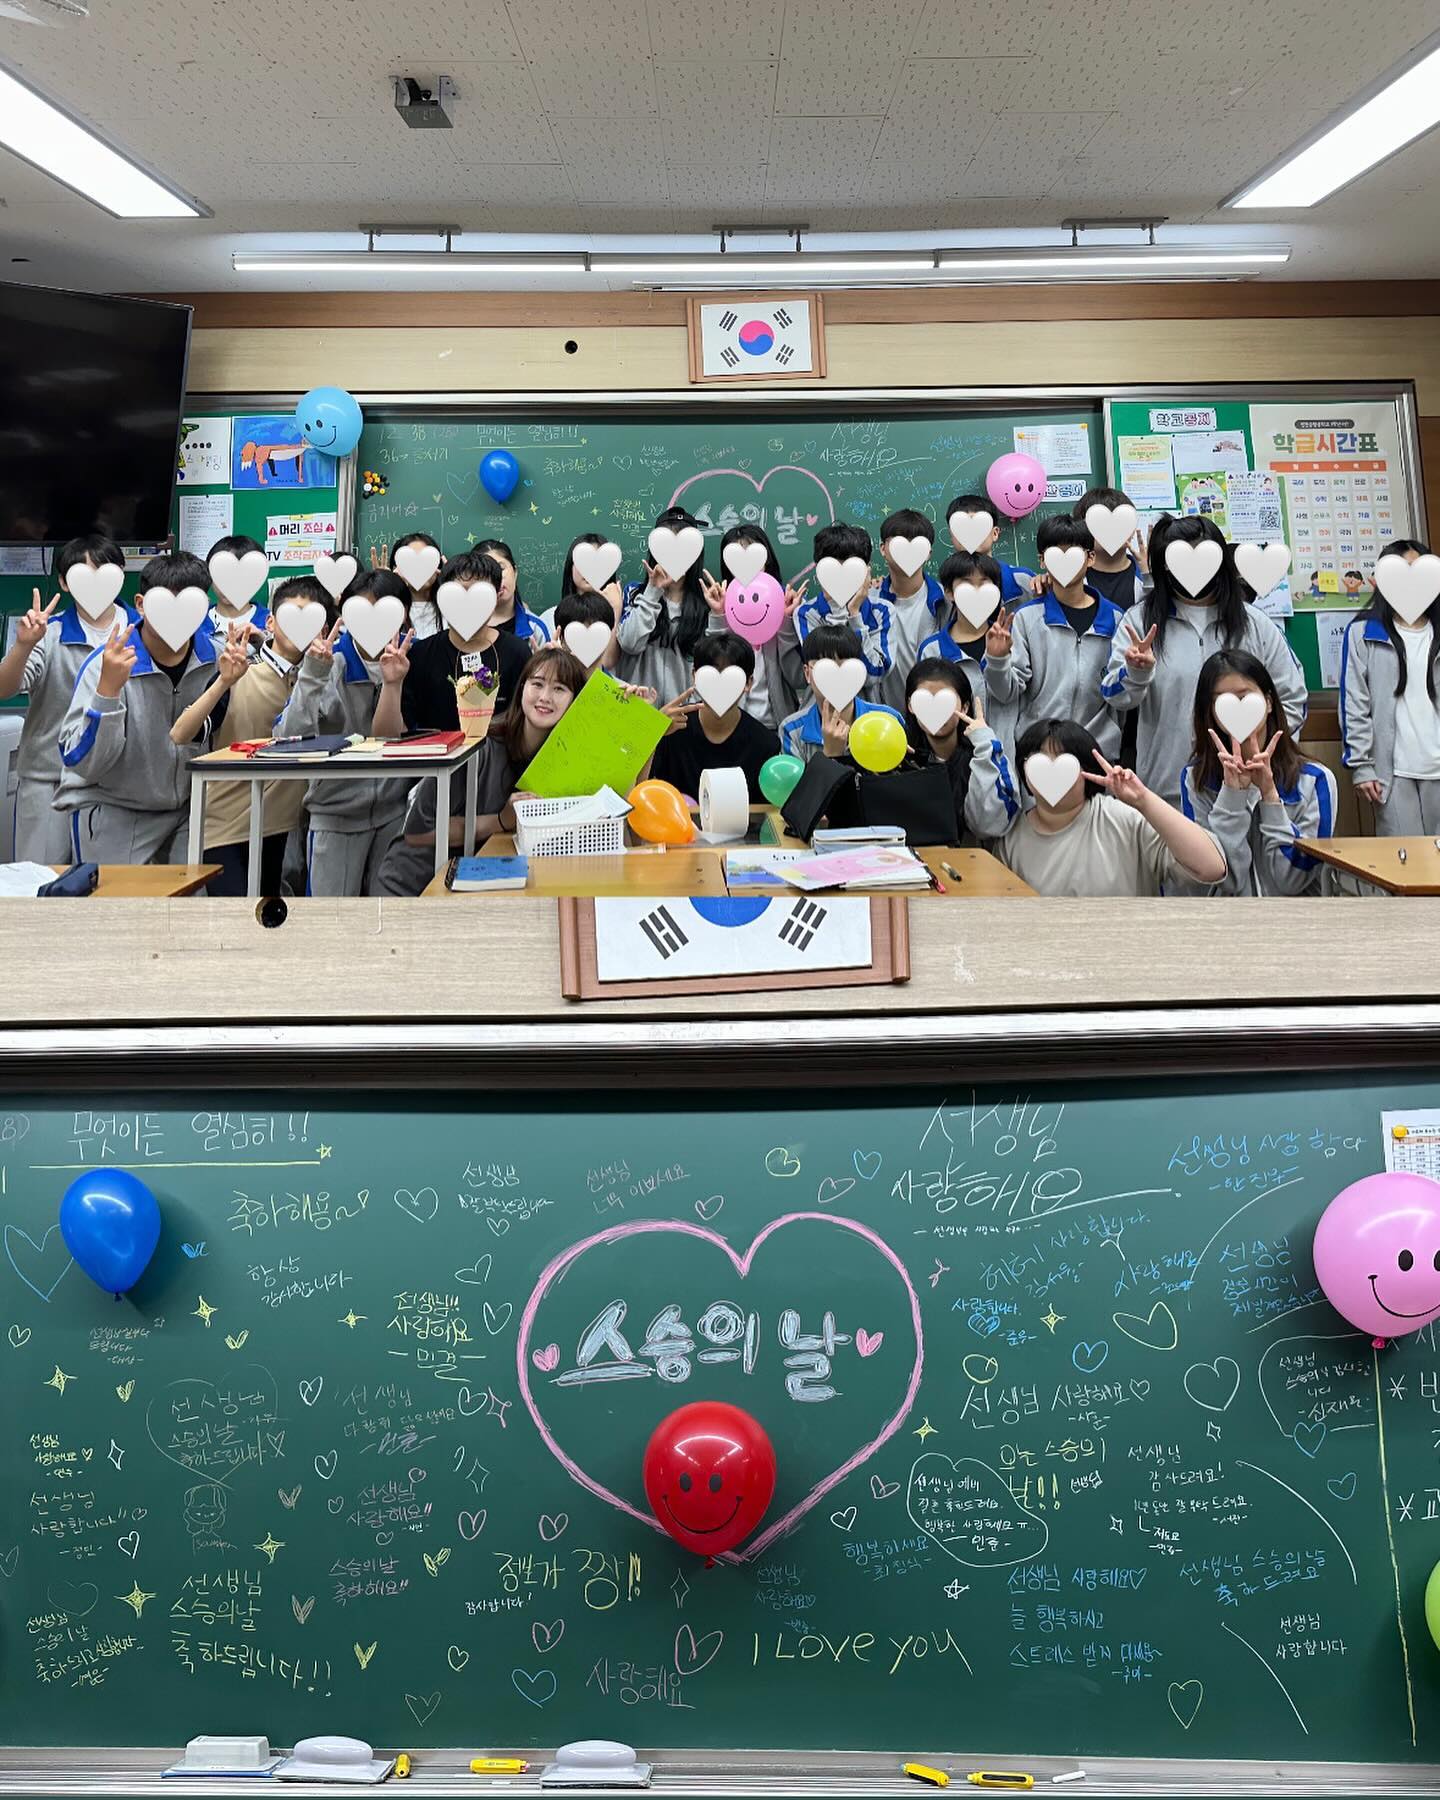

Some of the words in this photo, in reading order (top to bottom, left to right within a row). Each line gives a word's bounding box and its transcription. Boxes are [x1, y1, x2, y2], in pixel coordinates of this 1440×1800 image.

[1272, 433, 1379, 454] 학급시간표
[279, 523, 300, 536] 머리
[303, 522, 323, 534] 조심
[267, 551, 281, 561] TV
[67, 1110, 164, 1161] 무엇이든
[463, 1161, 520, 1188] 선생님
[549, 1299, 761, 1387] 스승의
[777, 1308, 853, 1402] 날
[171, 1391, 265, 1423] 선생님
[960, 1383, 1040, 1430] 선생님
[1051, 1381, 1130, 1411] 사랑해요
[1044, 1436, 1105, 1463] 스승의
[1127, 1443, 1182, 1465] 선생님
[357, 1479, 418, 1506] 선생님
[913, 1472, 954, 1495] 선생님
[30, 1491, 95, 1516] 선생님
[1152, 1525, 1181, 1542] 저도요
[181, 1569, 262, 1597] 선생님
[1007, 1565, 1061, 1594] 선생님
[1179, 1556, 1243, 1586] 선생님
[1008, 1603, 1027, 1632] 늘
[1035, 1604, 1106, 1634] 행복하시고
[1279, 1612, 1322, 1635] 선생님
[752, 1632, 760, 1666] I
[1009, 1641, 1077, 1669] 스트레스
[1275, 1638, 1348, 1660] 사랑합니다
